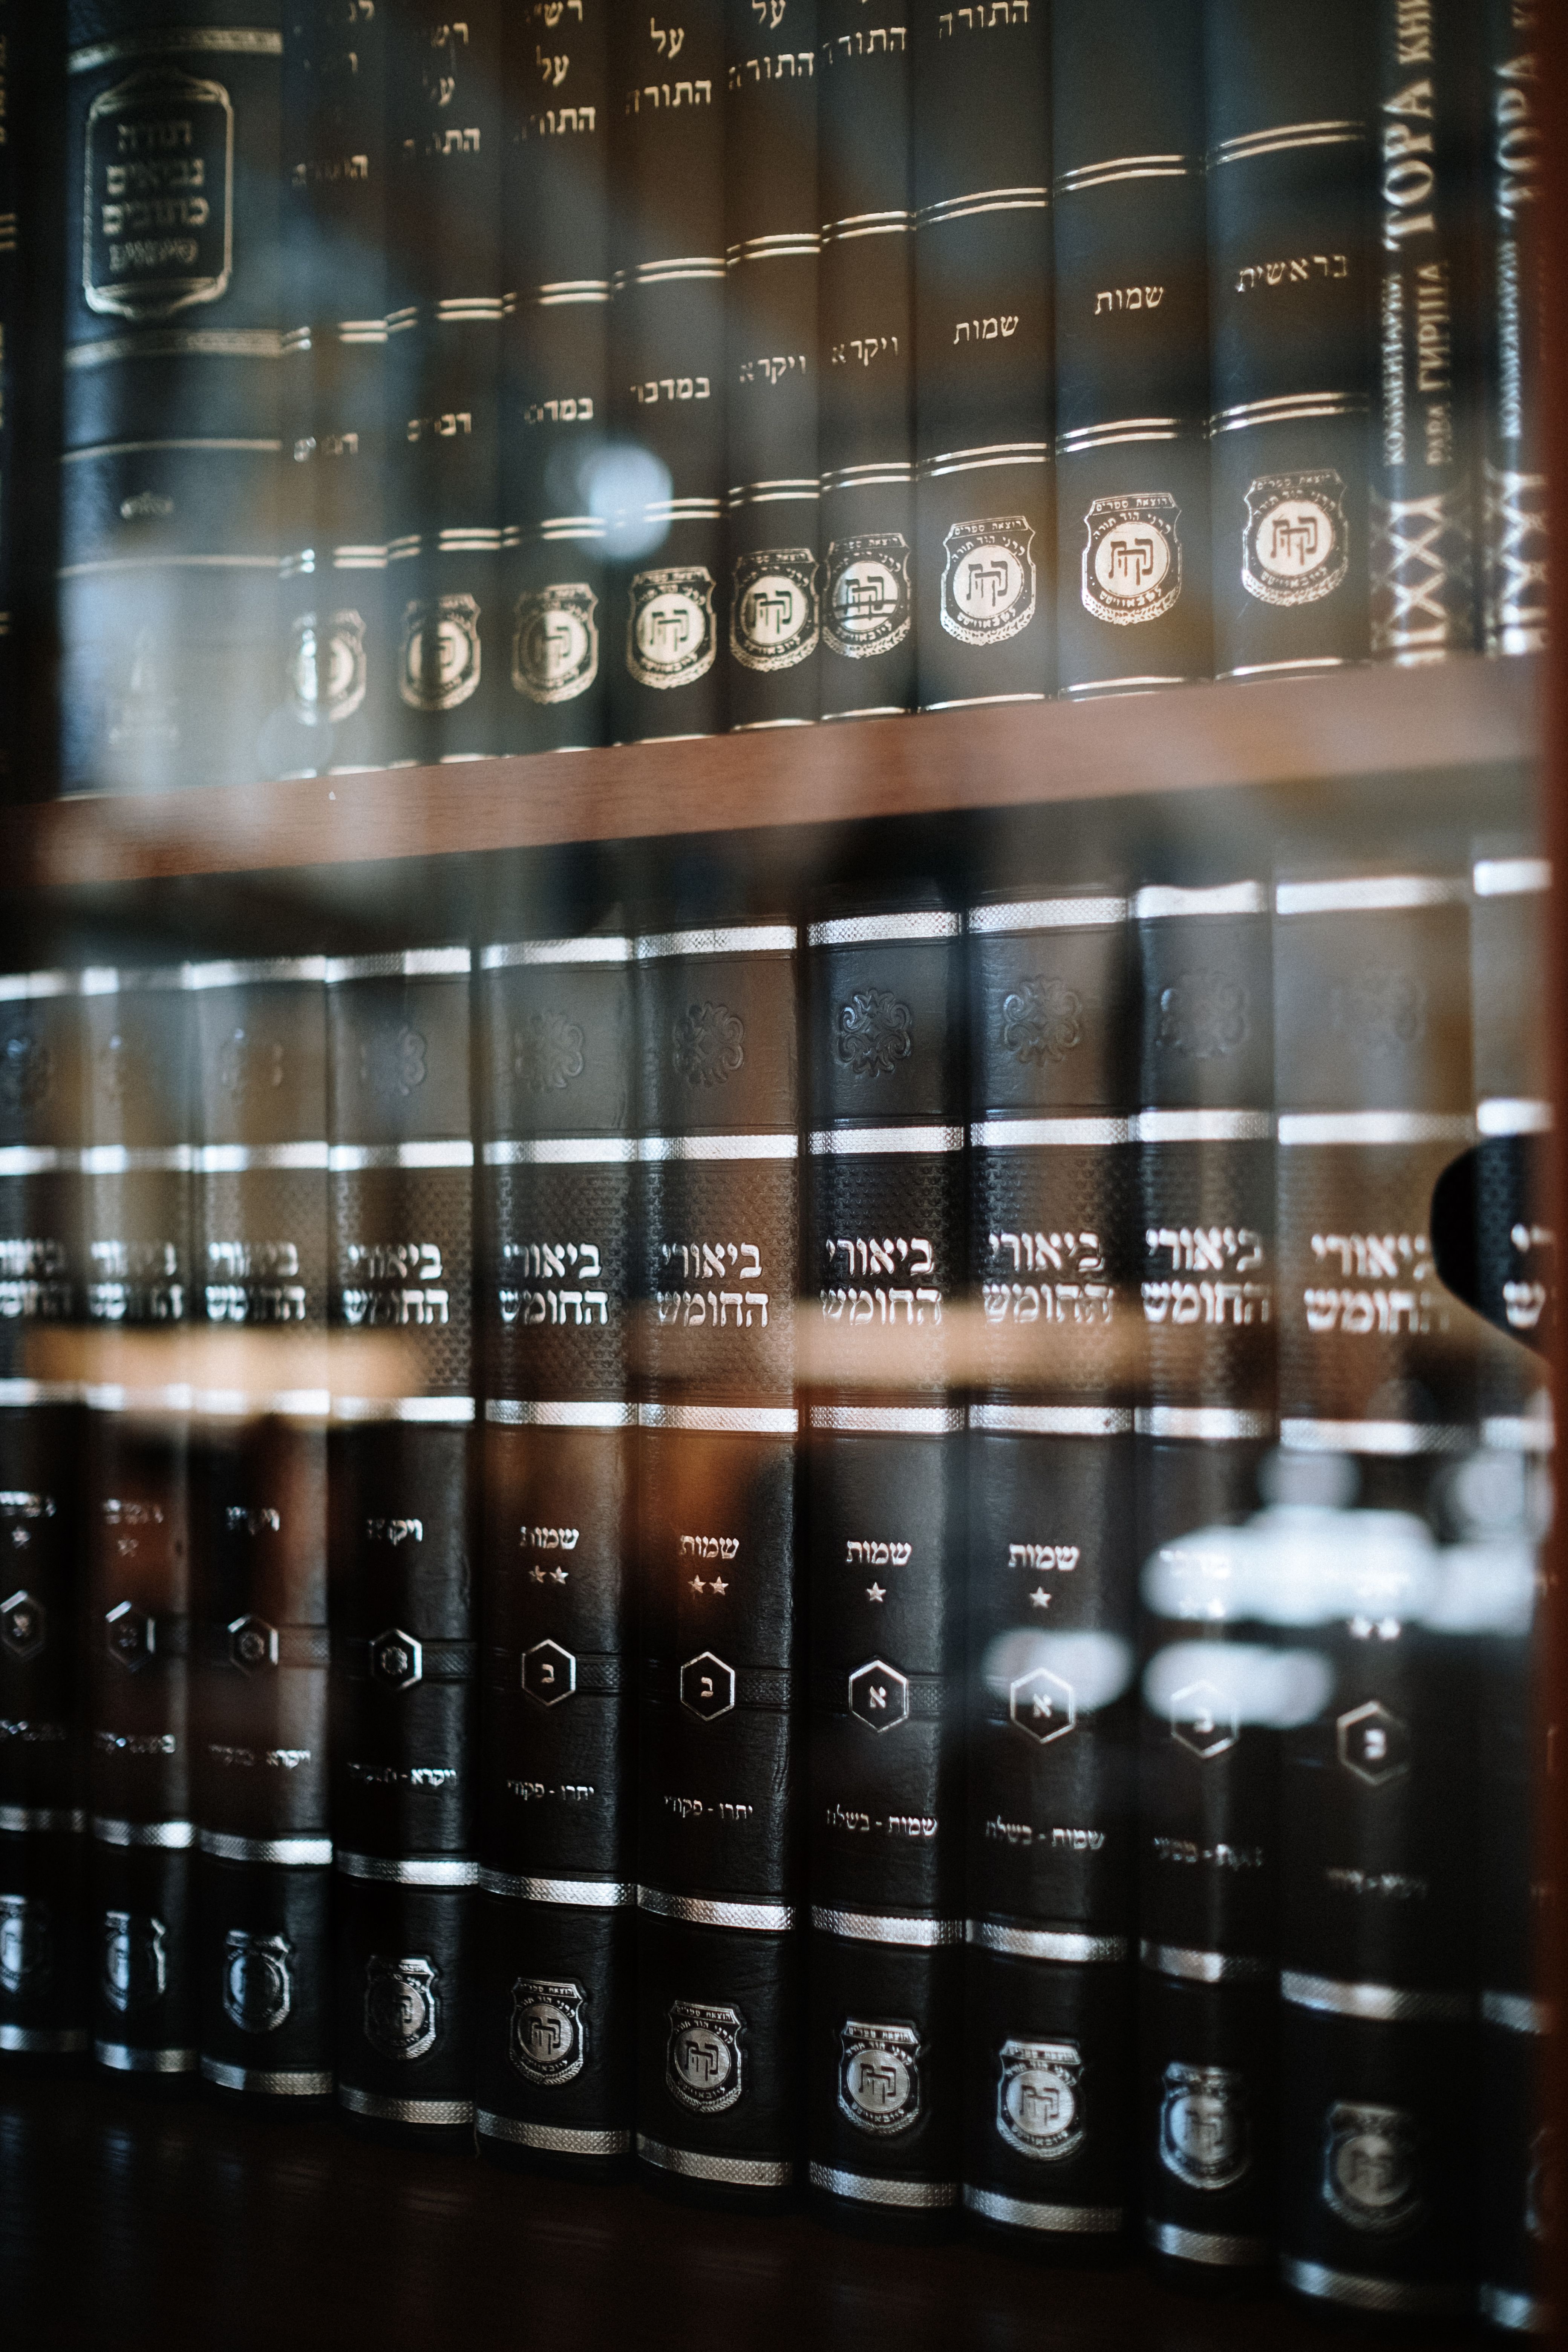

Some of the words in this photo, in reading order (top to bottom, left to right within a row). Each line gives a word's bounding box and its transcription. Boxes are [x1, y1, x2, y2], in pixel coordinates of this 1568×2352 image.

[939, 0, 1028, 39] התורה
[650, 18, 684, 59] על
[823, 27, 906, 64] התורה
[536, 45, 569, 87] על
[729, 52, 815, 90] התורה
[626, 80, 712, 115] התורה
[1237, 254, 1348, 293] בראשית
[1095, 286, 1164, 315] שמות
[954, 315, 1019, 345] שמות
[832, 337, 899, 366] ויקרא
[740, 355, 806, 384] ויקרא
[503, 1242, 602, 1279] ביאורי
[662, 1242, 762, 1280] ביאורי
[825, 1236, 934, 1276] ביאורי
[988, 1229, 1105, 1272] ביאורי
[1146, 1227, 1262, 1271] ביאורי
[500, 1289, 609, 1325] החומש
[657, 1290, 769, 1328] החומש
[820, 1287, 943, 1326] החומש
[982, 1283, 1113, 1323] החומש
[1141, 1282, 1271, 1325] החומש
[680, 1535, 740, 1560] שמות
[846, 1540, 913, 1566] שמות
[1008, 1544, 1080, 1571] שמות
[541, 1663, 555, 1684] ב
[700, 1677, 714, 1698] ב
[869, 1686, 887, 1709] א
[1033, 1693, 1052, 1718] א
[664, 1796, 703, 1818] פקודי
[720, 1803, 753, 1819] יתרו
[888, 1815, 938, 1836] שמות
[1052, 1827, 1105, 1850] שמות
